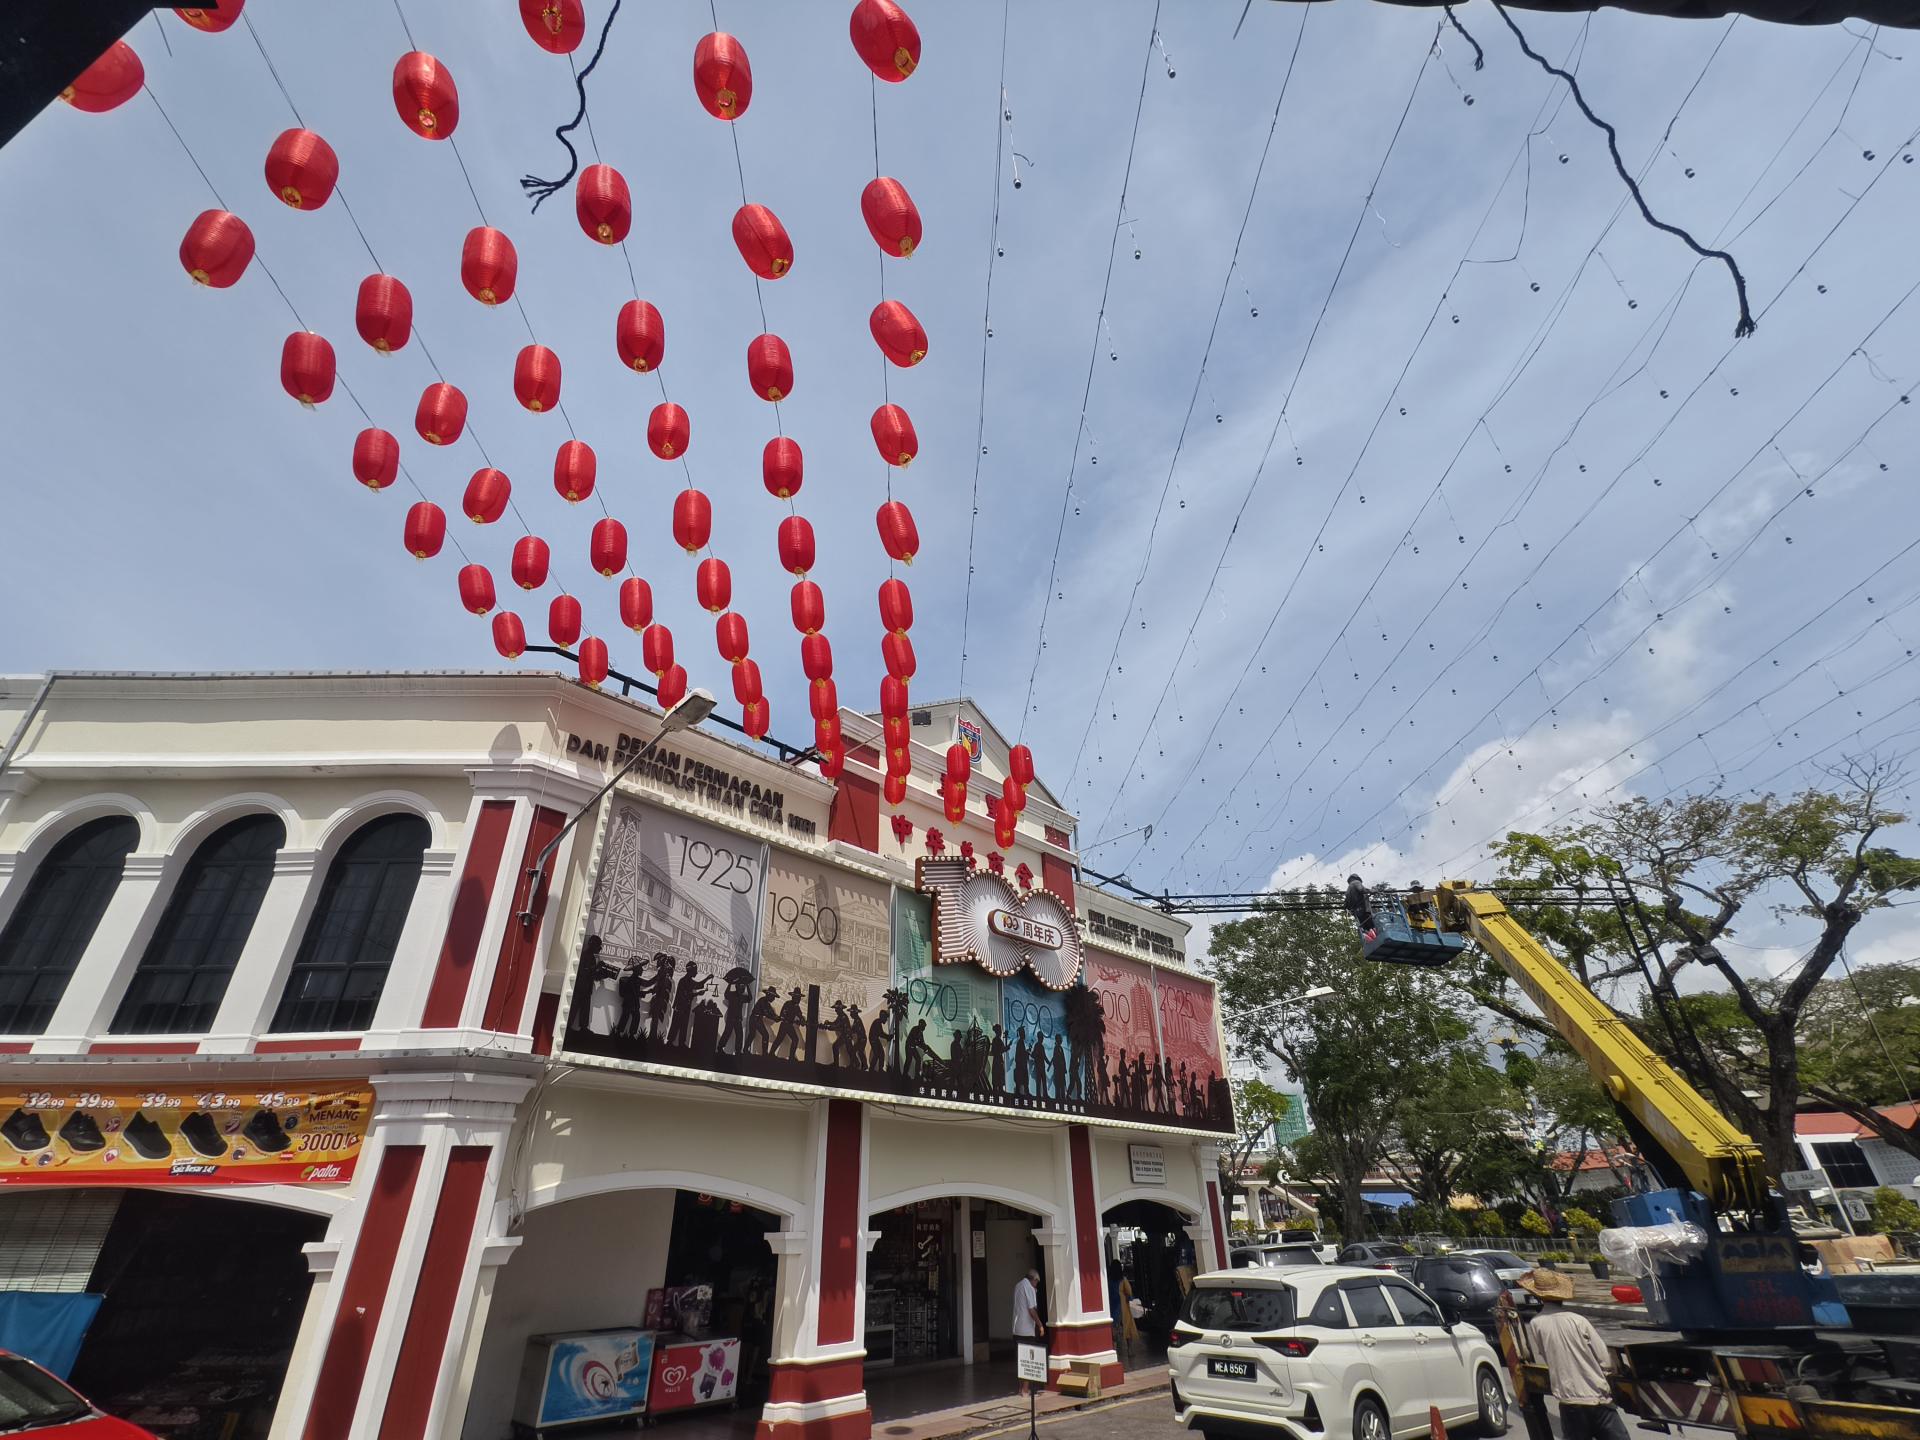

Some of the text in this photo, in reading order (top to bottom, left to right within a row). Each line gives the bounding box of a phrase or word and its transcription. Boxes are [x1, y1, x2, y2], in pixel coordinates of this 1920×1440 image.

[567, 734, 817, 836] DAN PERINDUSTRIAN CINA MIRI
[617, 733, 784, 808] DEWAN PERNIAGAAN
[678, 835, 753, 894] 1925
[769, 892, 838, 945] 1950
[1023, 921, 1055, 945] 周年庆
[1107, 916, 1139, 937] CHINESE
[903, 976, 958, 1021] 1970
[1158, 984, 1194, 1019] 2025
[1005, 997, 1053, 1038] 1990
[75, 1093, 115, 1109] 39.99
[141, 1093, 181, 1108] 39.99
[309, 1109, 360, 1122] MENANG
[307, 1164, 341, 1181] pallas
[1214, 1362, 1248, 1376] MEA 8567
